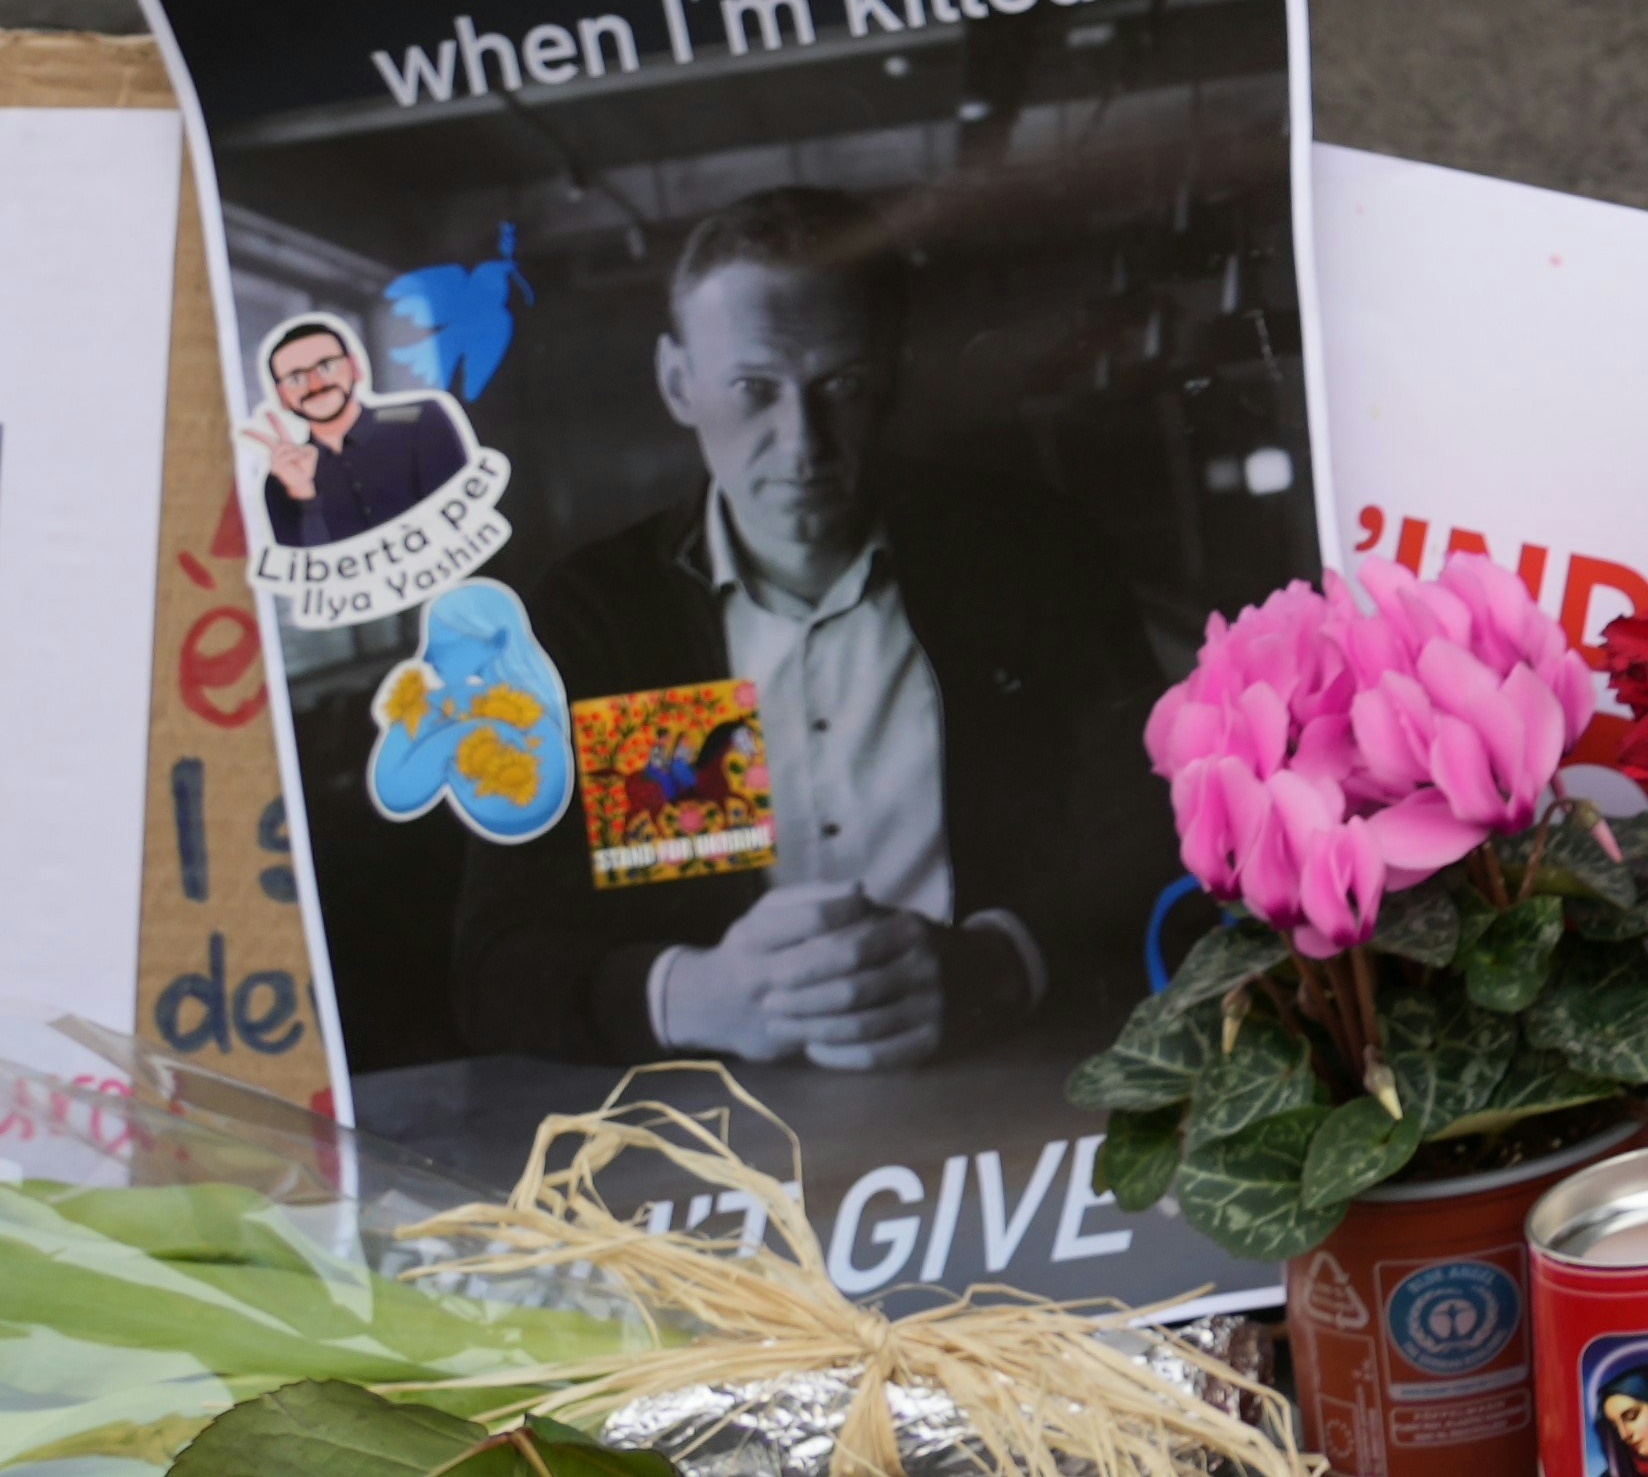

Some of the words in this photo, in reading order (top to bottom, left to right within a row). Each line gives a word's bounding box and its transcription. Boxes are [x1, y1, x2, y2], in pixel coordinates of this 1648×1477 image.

[373, 13, 640, 109] when
[257, 523, 430, 583] Libertà
[439, 456, 499, 531] per
[302, 589, 372, 621] Ilya
[385, 521, 502, 600] Yashin
[829, 1134, 1134, 1296] GIVE
